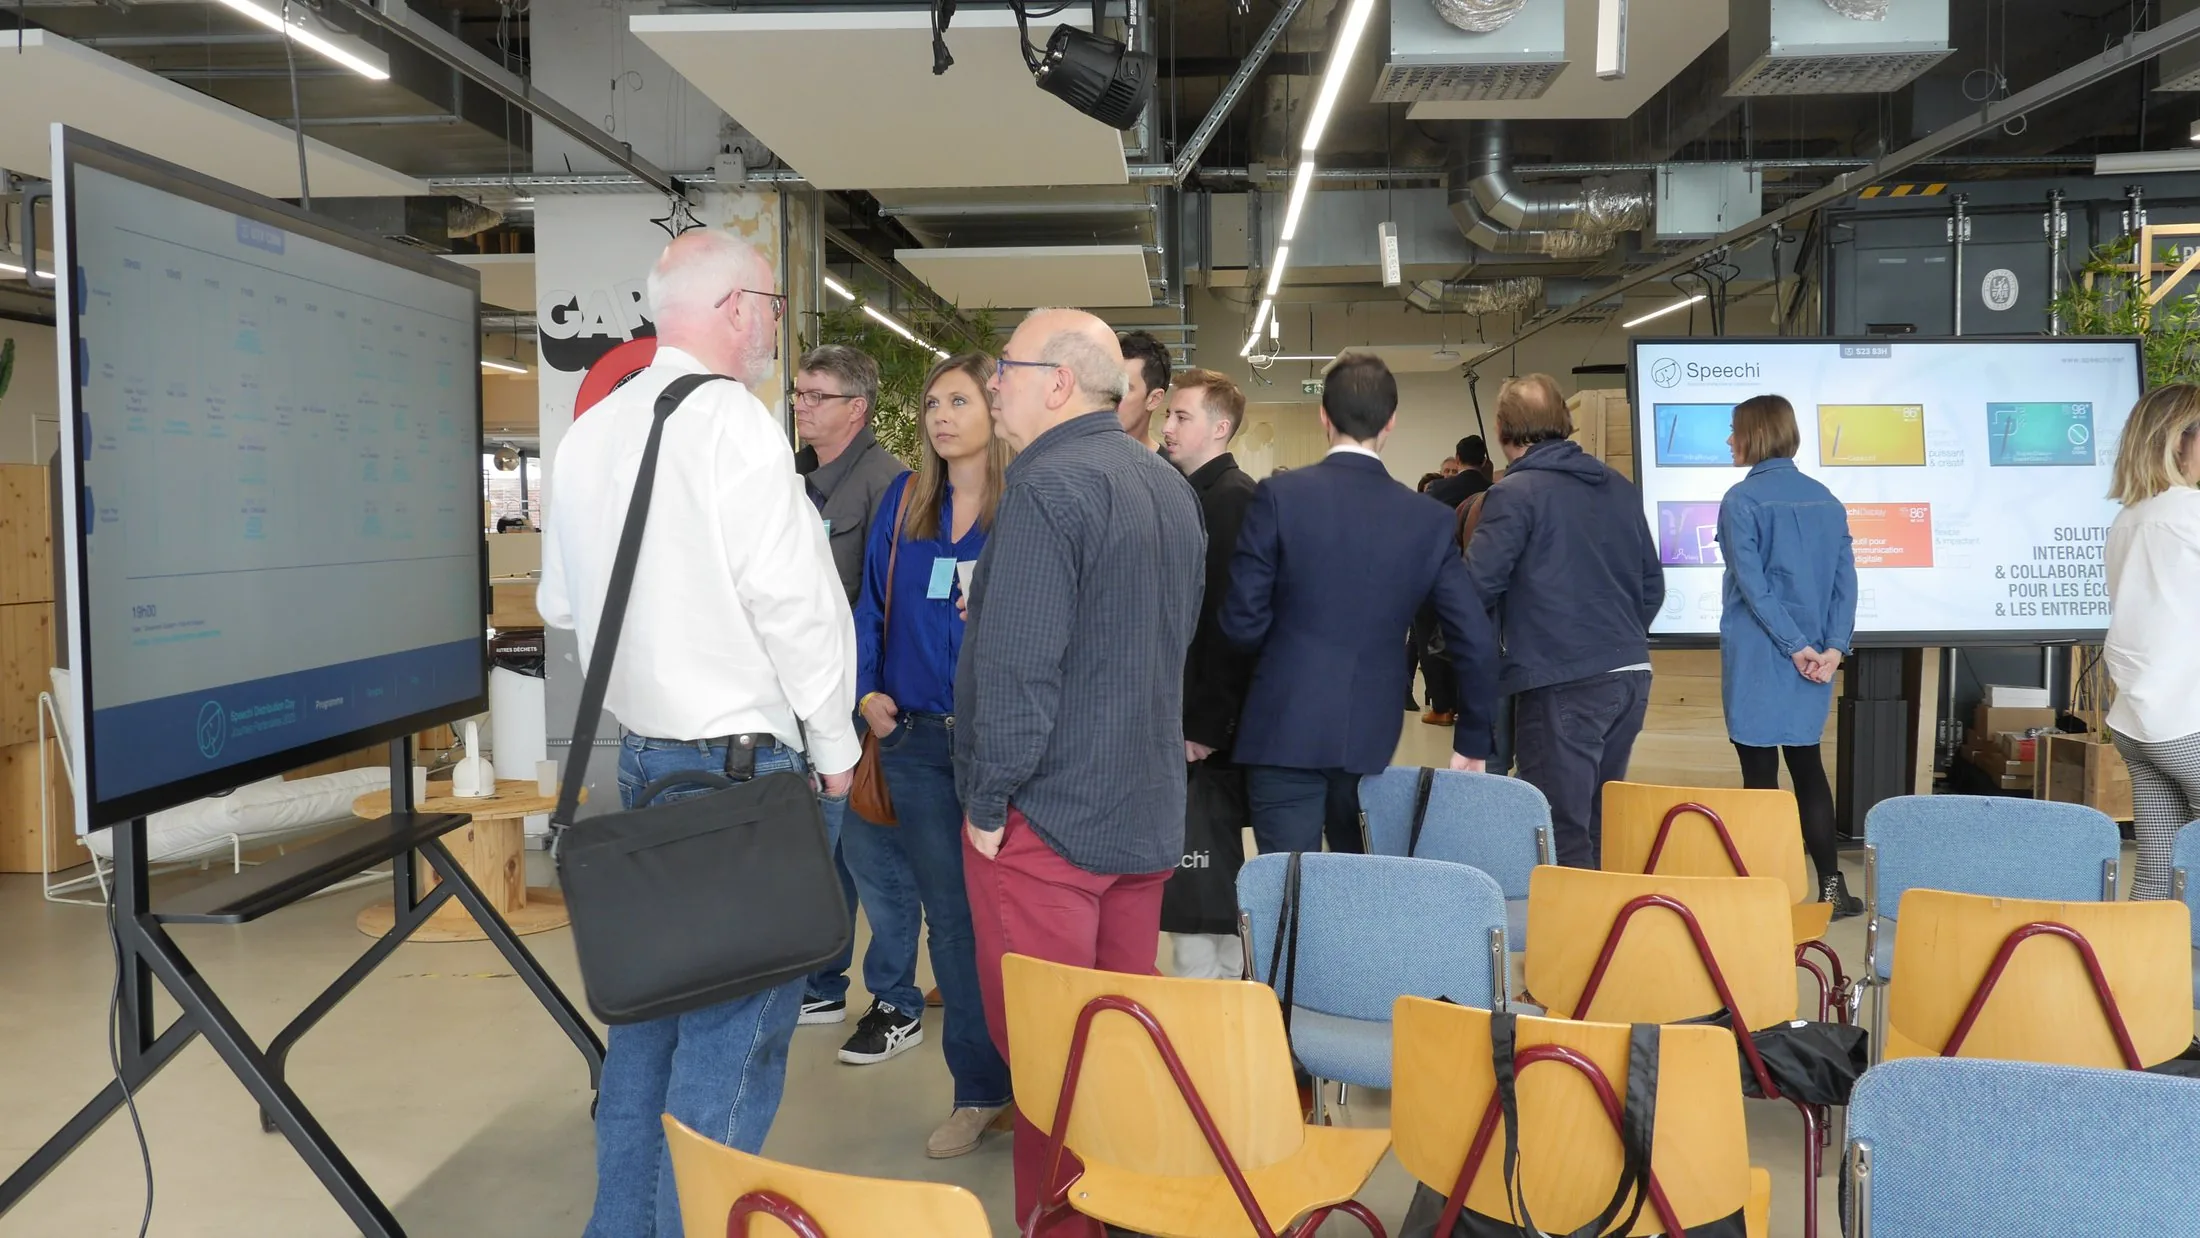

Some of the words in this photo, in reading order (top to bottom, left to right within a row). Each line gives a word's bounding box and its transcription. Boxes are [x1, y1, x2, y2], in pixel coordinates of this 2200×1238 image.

[1687, 362, 1760, 381] Speechi
[2033, 546, 2104, 560] INTERACT
[1995, 565, 2006, 579] &
[2010, 564, 2105, 579] COLLABORAT
[2009, 583, 2048, 597] POUR
[2053, 583, 2079, 597] LES
[1995, 602, 2006, 616] &
[2010, 602, 2037, 616] LES
